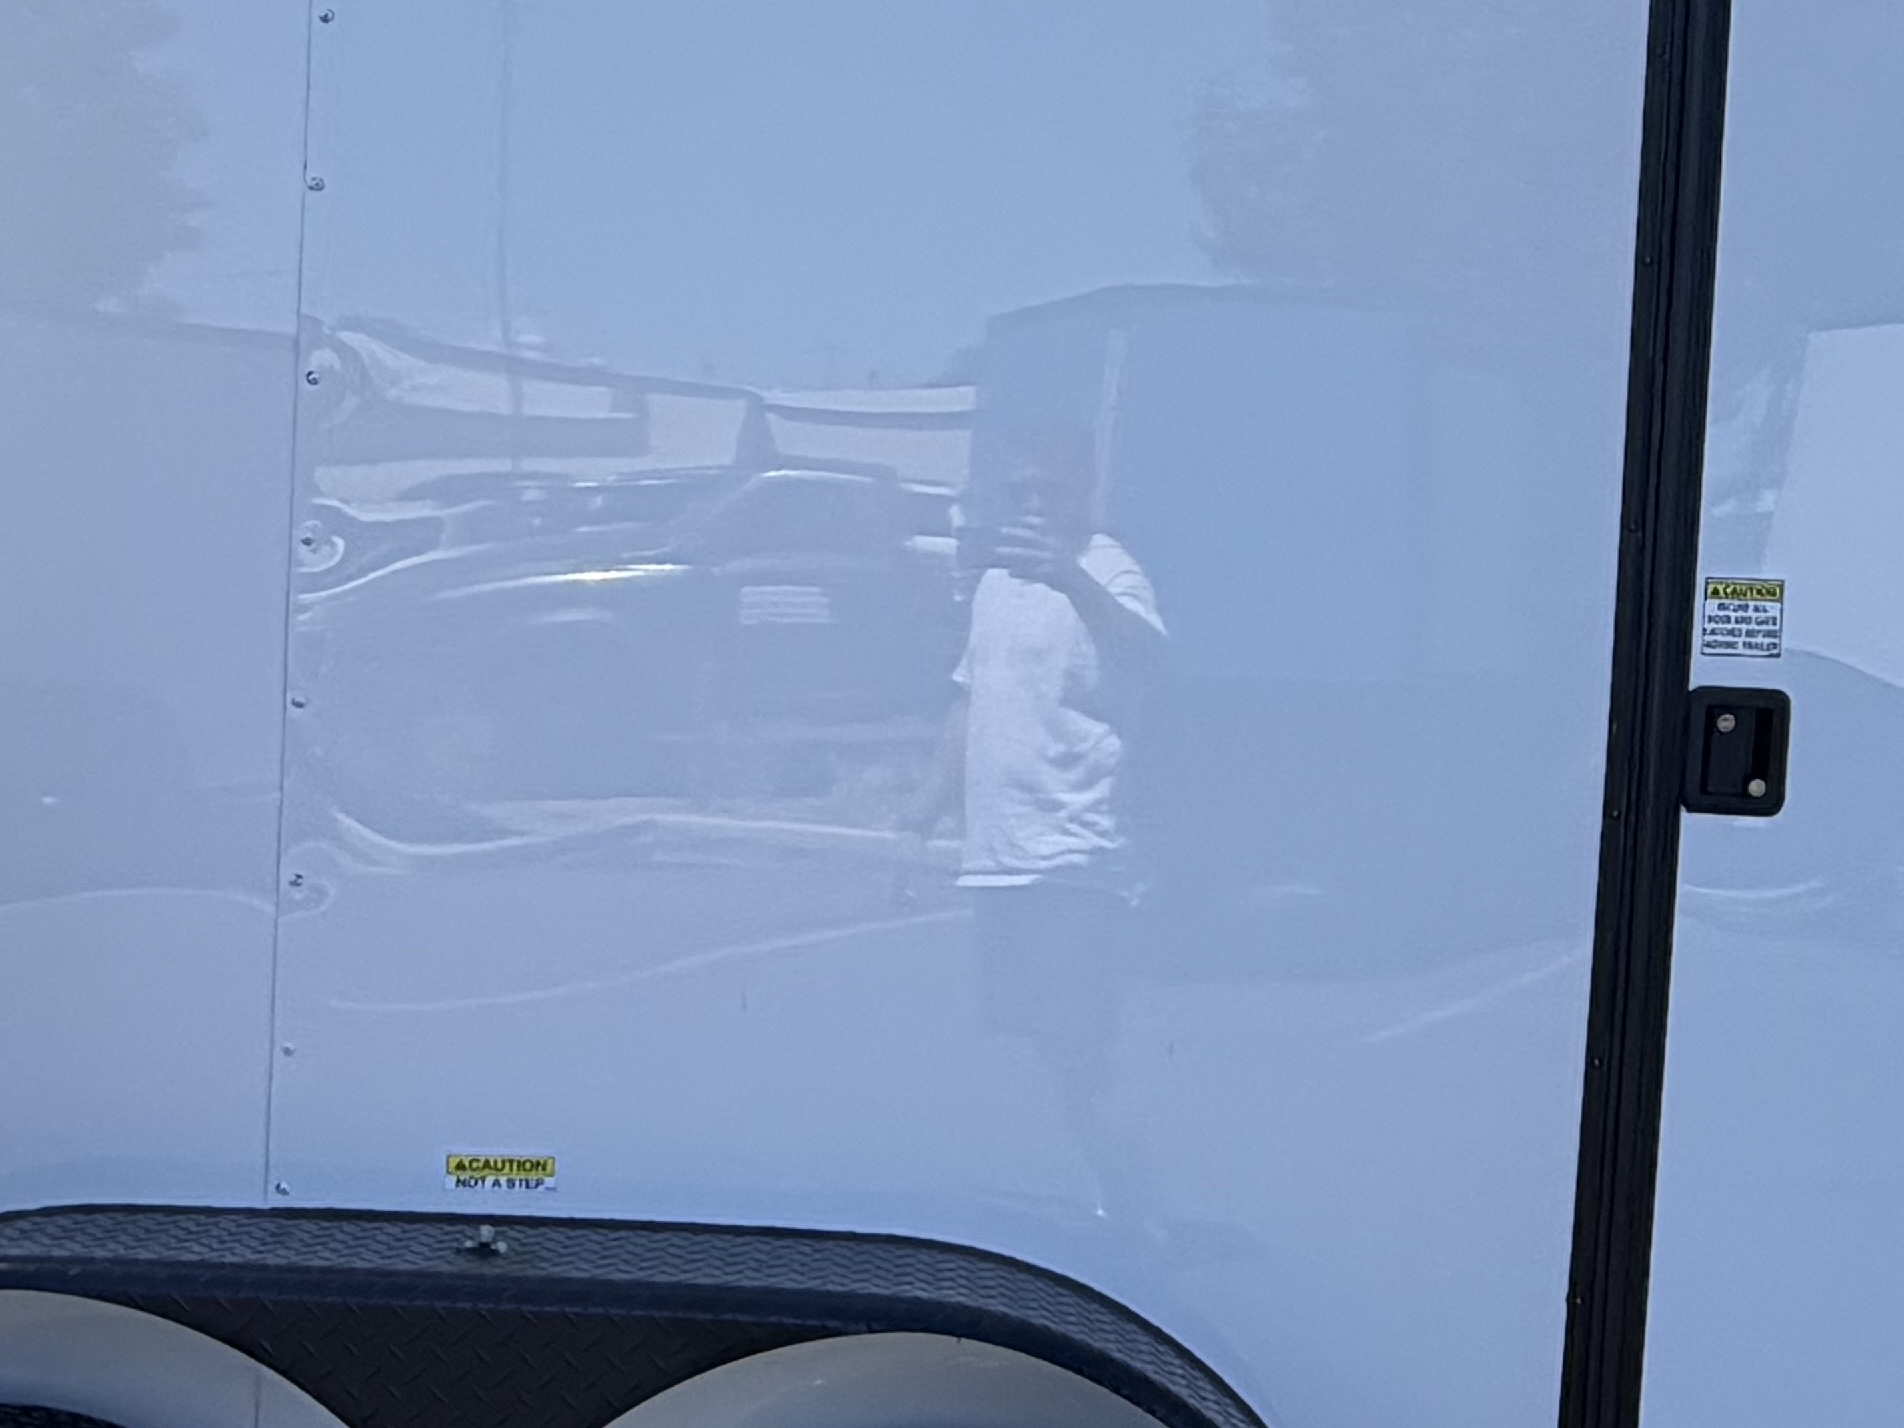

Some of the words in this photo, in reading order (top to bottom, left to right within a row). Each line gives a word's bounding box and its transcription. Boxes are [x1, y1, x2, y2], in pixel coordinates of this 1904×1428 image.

[468, 1158, 547, 1173] CAUTION
[455, 1176, 488, 1189] NOT
[491, 1177, 502, 1189] A
